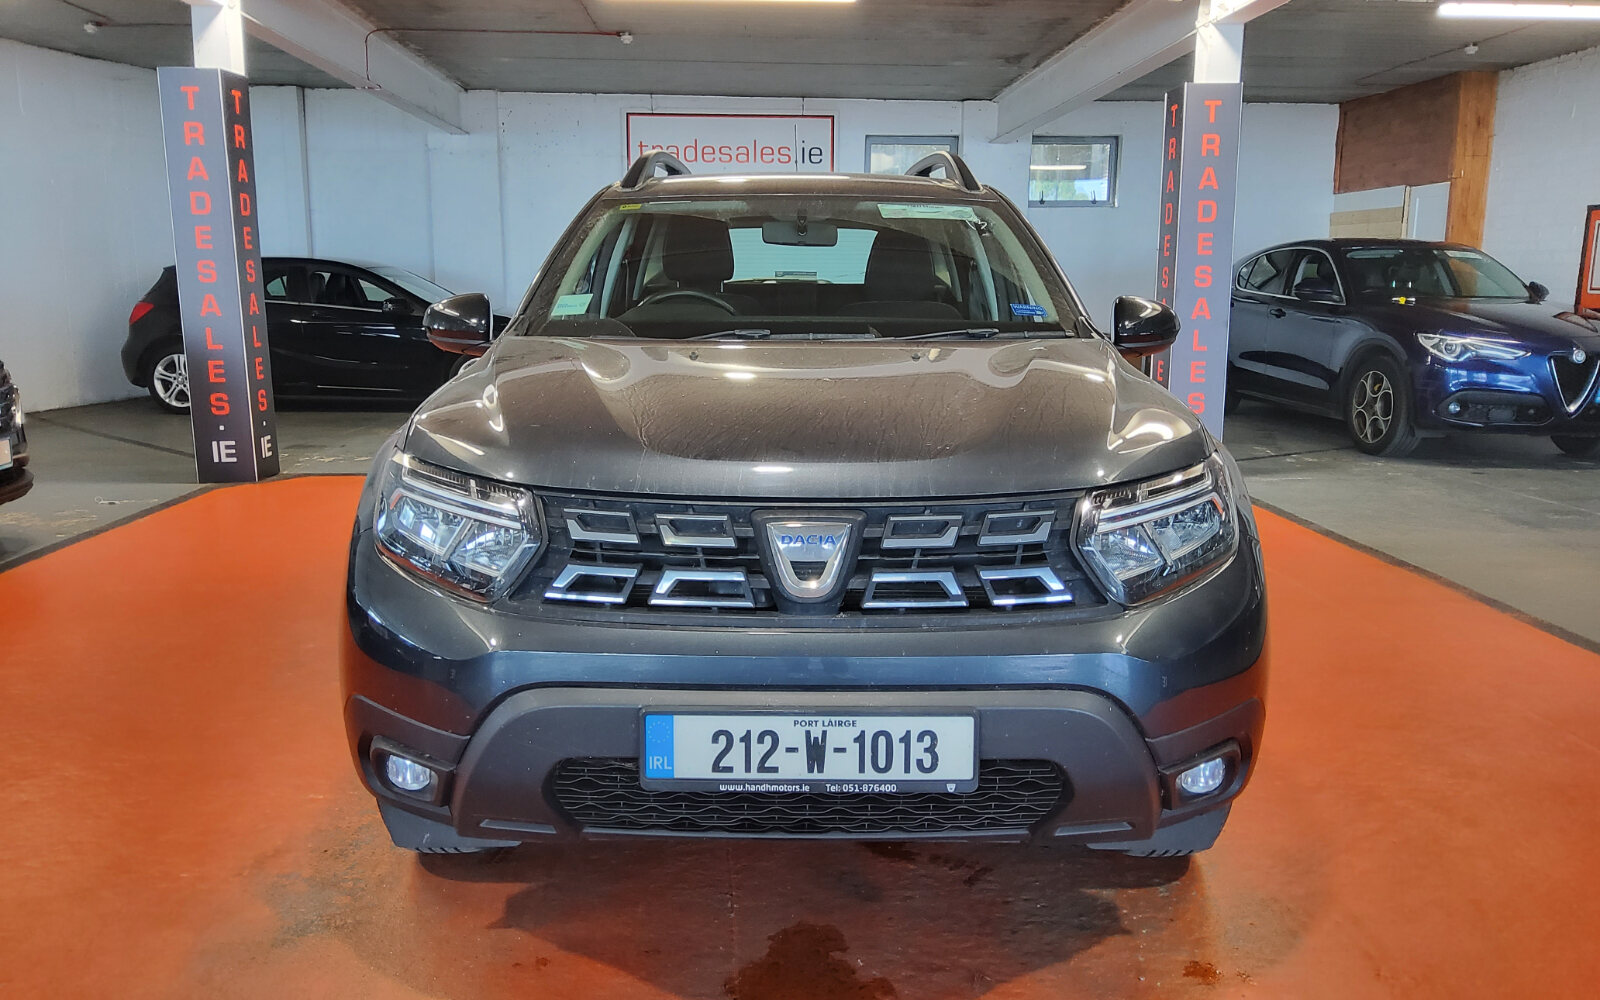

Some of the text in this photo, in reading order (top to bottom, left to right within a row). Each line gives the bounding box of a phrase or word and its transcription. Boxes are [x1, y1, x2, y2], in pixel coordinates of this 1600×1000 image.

[780, 534, 837, 545] DACIA
[793, 719, 820, 728] PORT
[711, 729, 939, 774] 212-W-1013
[649, 756, 672, 770] IRL
[719, 783, 897, 792] www.handhmotors.ie Tel: 051-876400
